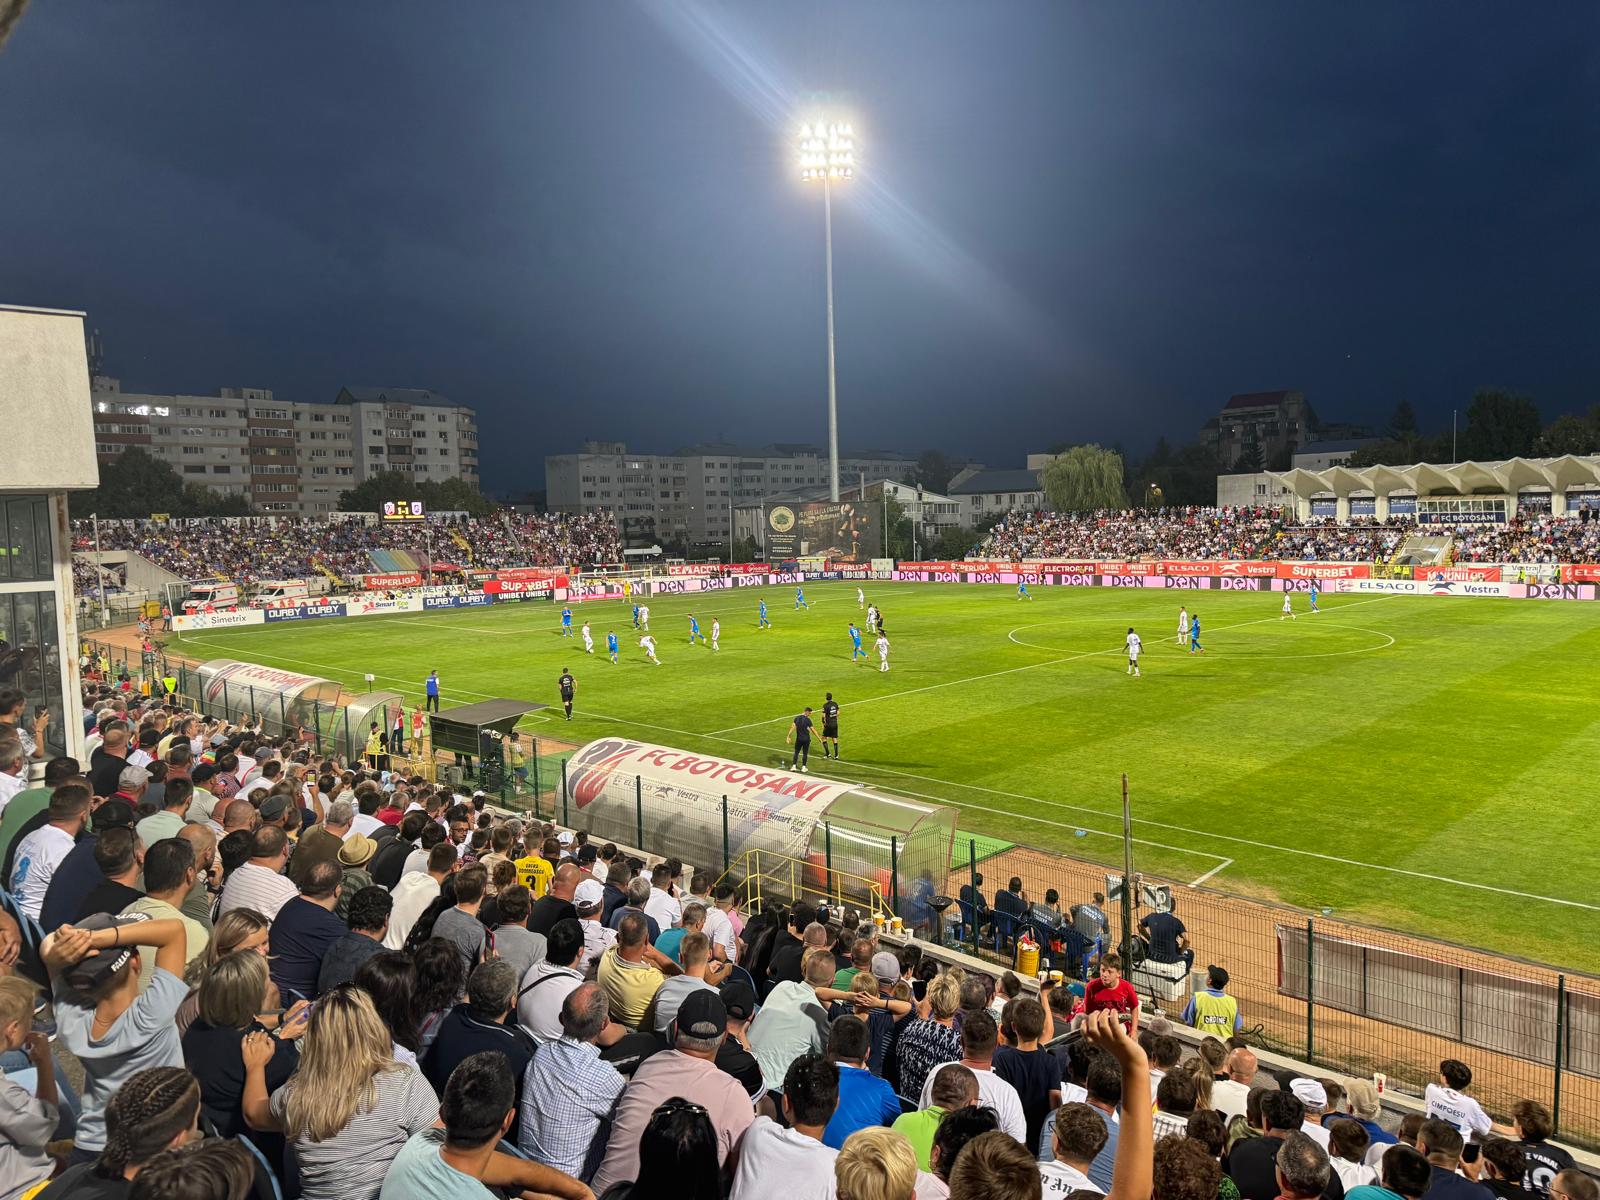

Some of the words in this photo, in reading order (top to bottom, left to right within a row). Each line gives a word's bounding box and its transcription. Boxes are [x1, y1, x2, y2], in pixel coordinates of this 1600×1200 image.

[833, 563, 868, 571] UPERLIGA
[1247, 566, 1276, 574] Vestra
[1292, 566, 1354, 577] SUPERBET
[371, 575, 417, 586] SUPERLIGA
[738, 576, 762, 587] DON
[776, 573, 798, 583] DON
[899, 571, 921, 581] DON
[934, 572, 960, 583] DON
[975, 572, 1001, 583] DON
[1061, 574, 1092, 586] DON
[1111, 576, 1144, 587] DON
[1427, 571, 1486, 581] MNUNILOR
[501, 578, 554, 591] SUPRBET
[660, 580, 685, 593] DON
[700, 578, 725, 590] DON
[1165, 576, 1200, 589] DON
[1220, 577, 1259, 591] DON
[1359, 581, 1415, 591] ELSACO
[498, 591, 524, 600] UNIBET
[525, 589, 551, 598] UNIBET
[1463, 584, 1500, 594] Vestra
[1526, 583, 1578, 599] DON
[211, 614, 247, 625] Simetrix
[636, 749, 669, 768] FC
[623, 779, 653, 791] ELSCO
[676, 789, 700, 802] Vestra
[768, 812, 792, 824] Smart
[1431, 1100, 1466, 1119] CIMPOESU
